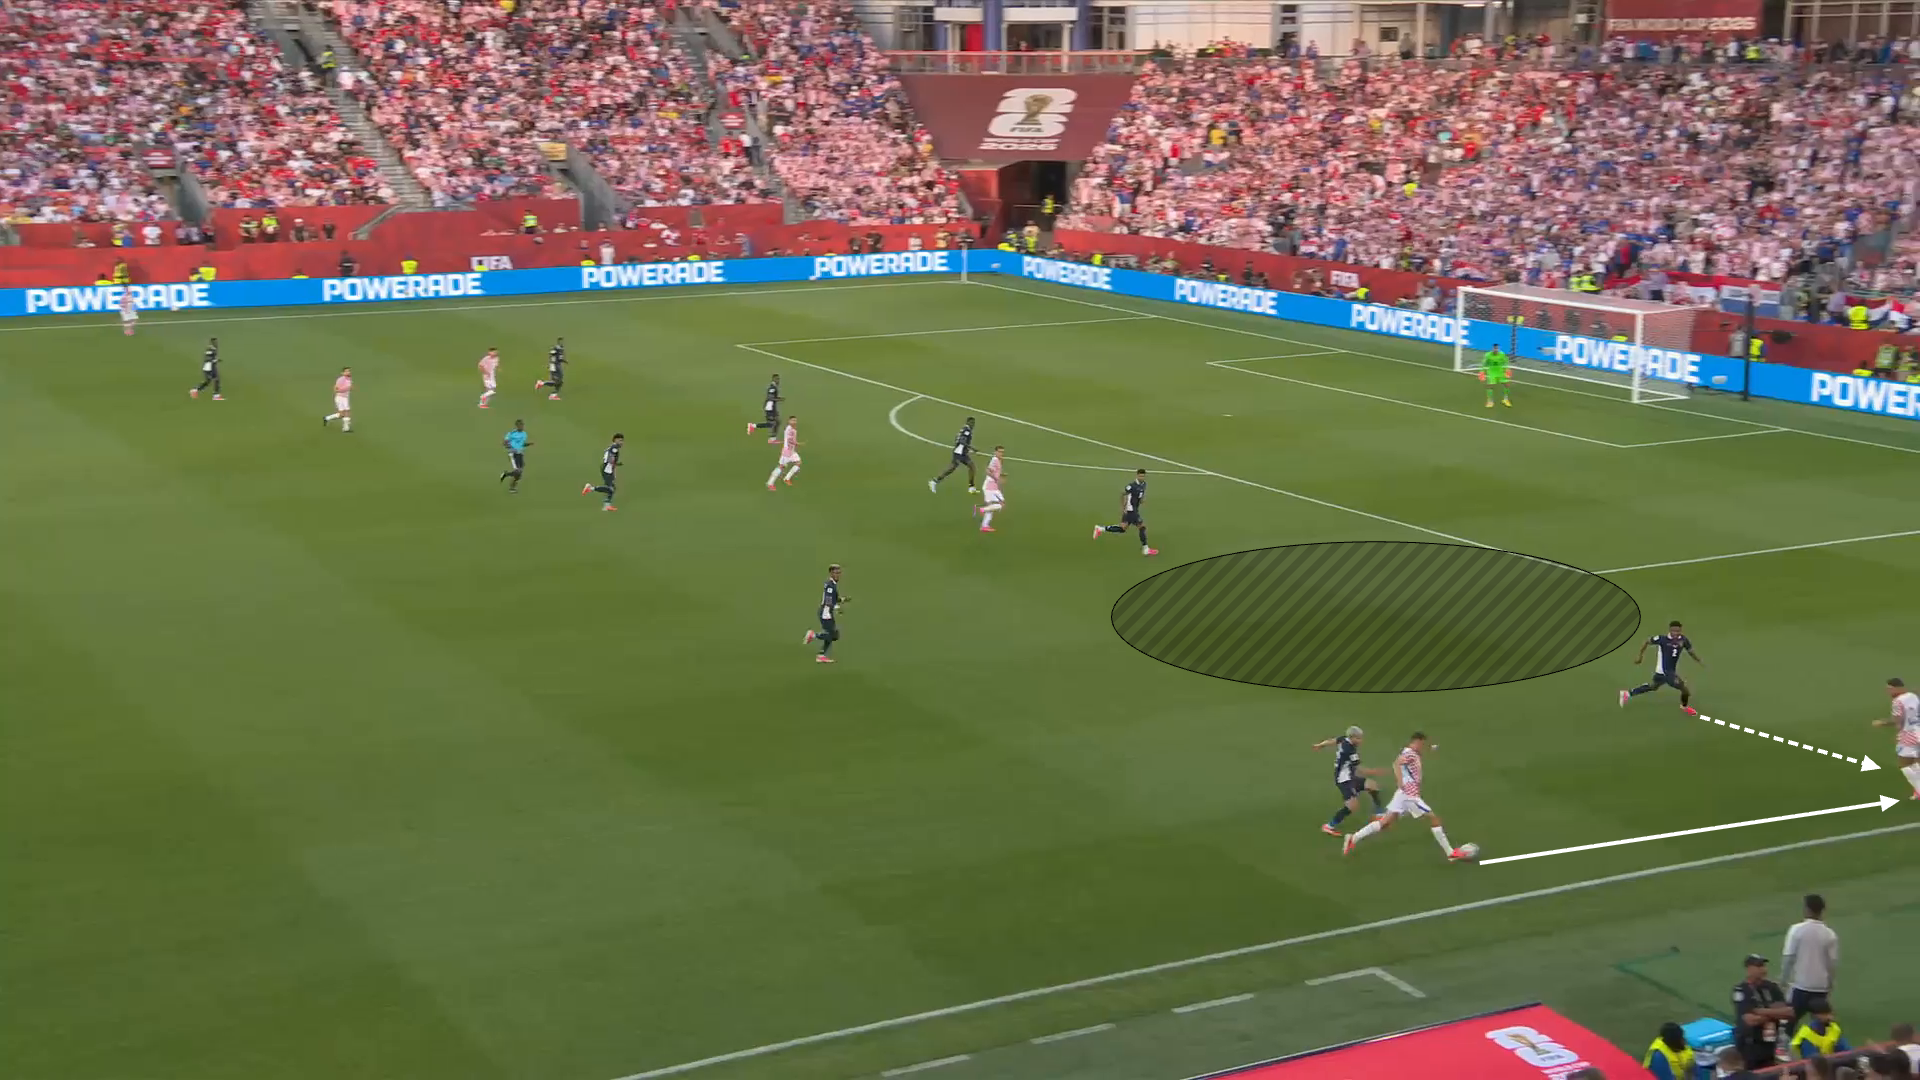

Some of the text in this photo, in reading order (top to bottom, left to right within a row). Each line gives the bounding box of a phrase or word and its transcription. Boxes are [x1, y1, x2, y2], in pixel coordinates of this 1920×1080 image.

[582, 261, 725, 288] POWERADE
[815, 251, 950, 278] POWERADE
[1024, 255, 1112, 290] POWERADE
[26, 283, 211, 313] POWERADE
[323, 273, 483, 301] POWERADE
[1176, 278, 1278, 315] POWERADE
[1351, 303, 1471, 346] POWERADE
